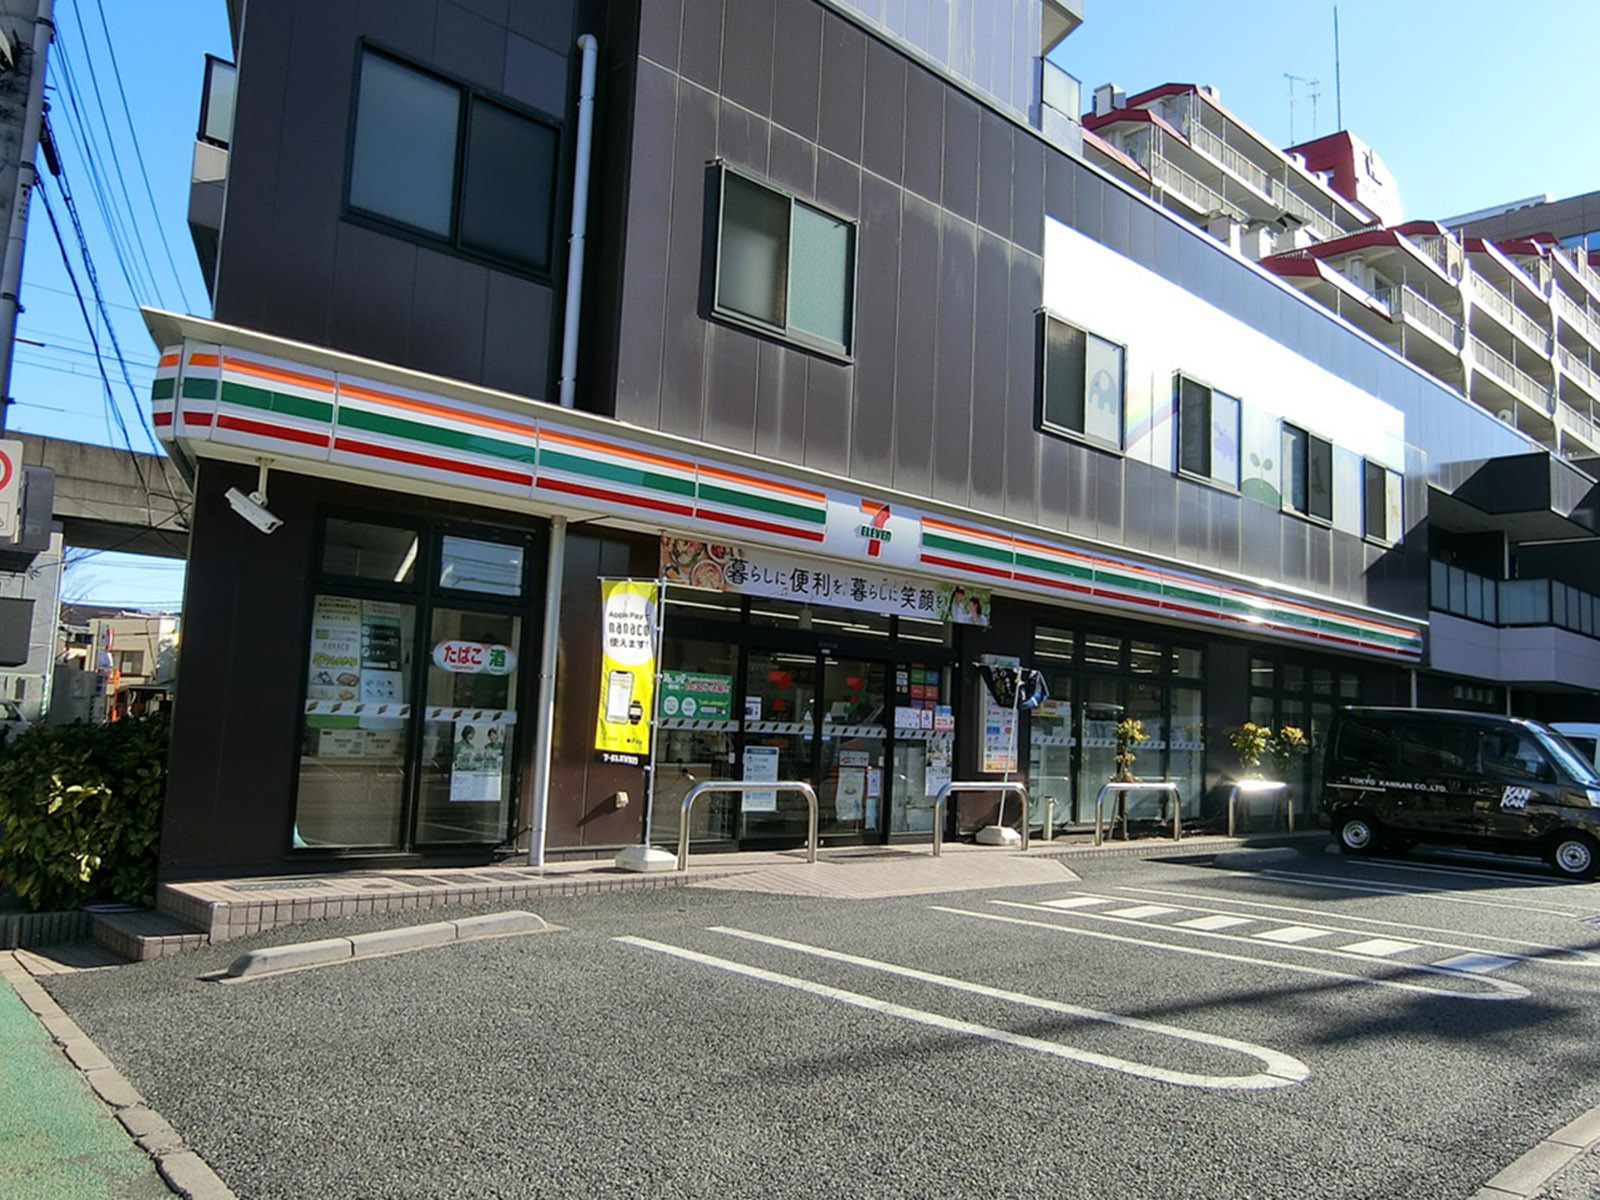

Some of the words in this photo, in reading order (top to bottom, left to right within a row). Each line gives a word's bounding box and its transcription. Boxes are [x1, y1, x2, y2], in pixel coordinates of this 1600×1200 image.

[608, 622, 650, 637] nanaco
[444, 644, 483, 665] たばこ
[489, 648, 507, 668] 酒
[1349, 777, 1376, 786] TOKYO
[1502, 786, 1531, 798] KAN
